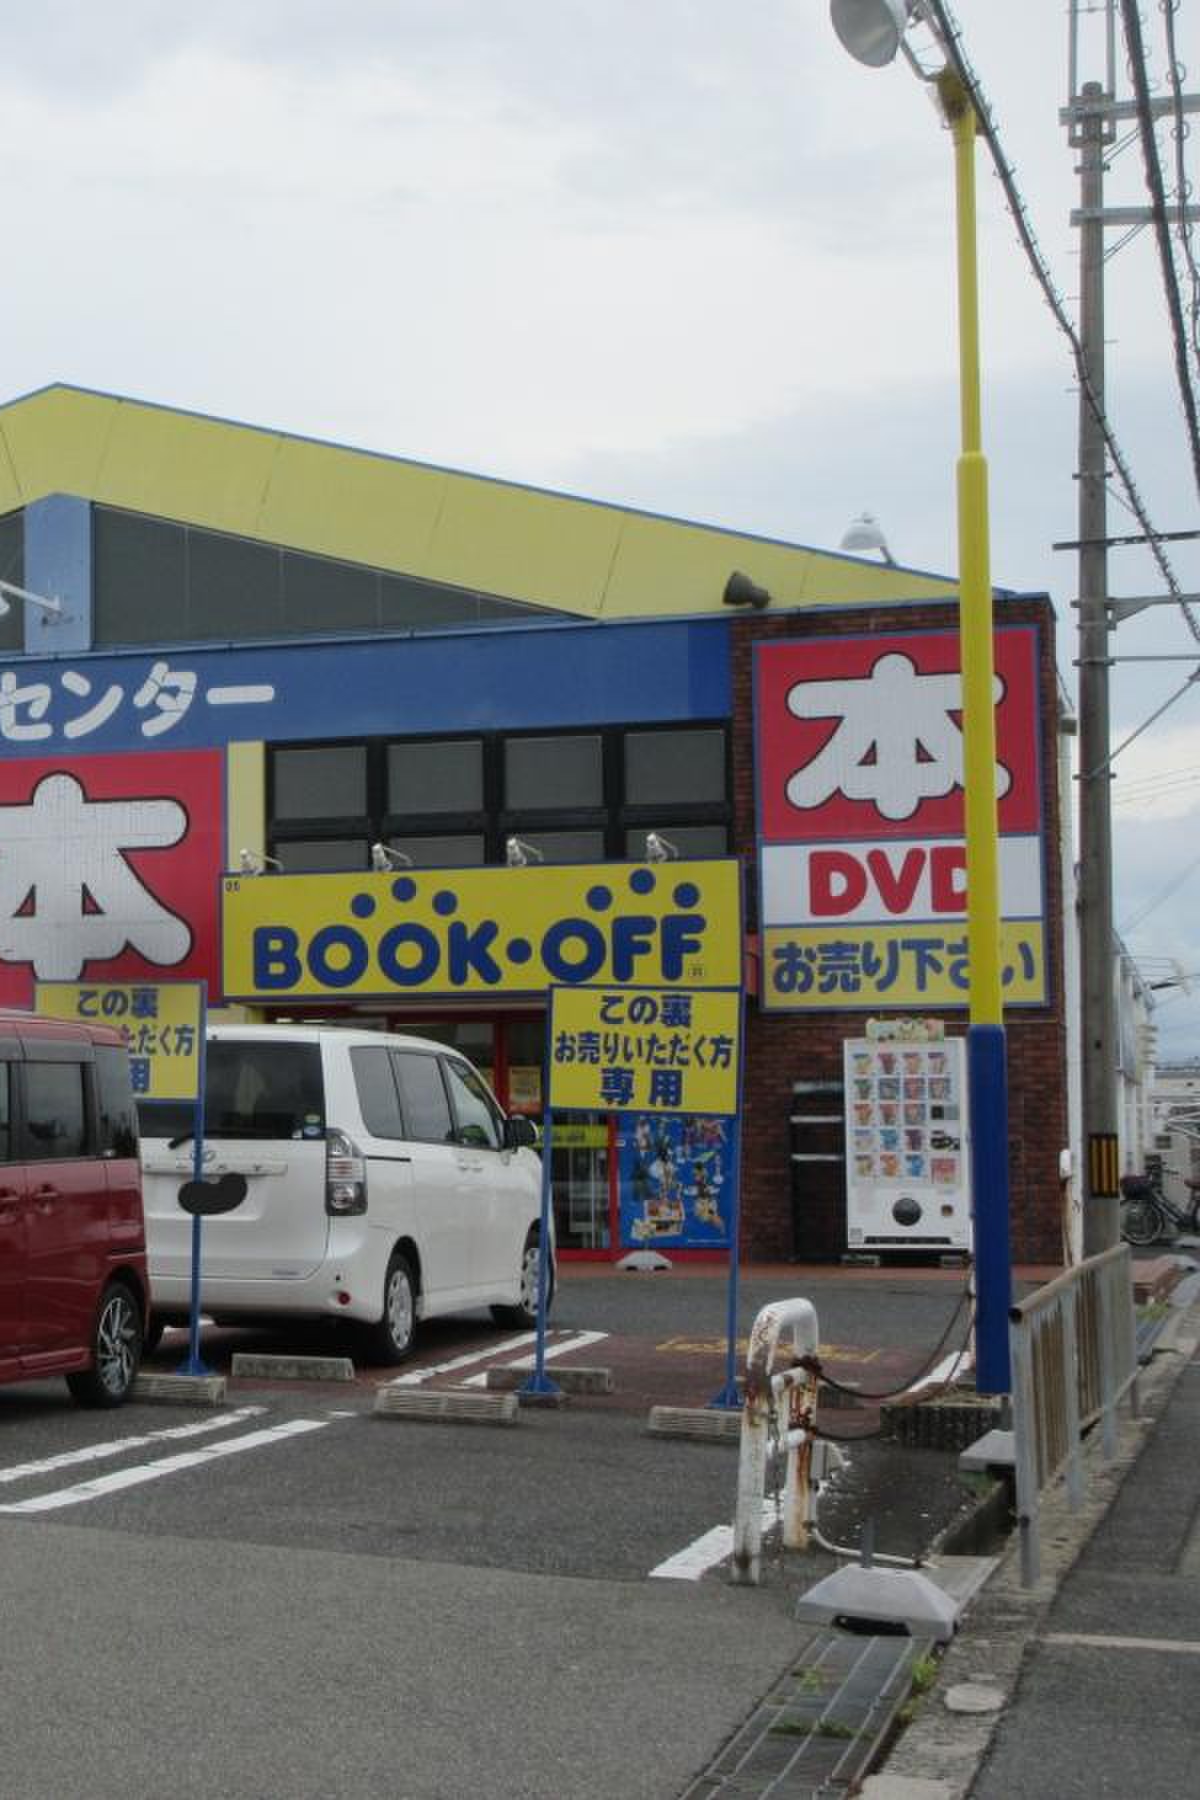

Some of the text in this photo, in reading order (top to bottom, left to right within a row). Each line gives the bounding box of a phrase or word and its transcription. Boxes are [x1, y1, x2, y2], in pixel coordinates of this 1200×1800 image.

[785, 652, 1012, 821] 本
[809, 846, 969, 916] DVD
[78, 987, 158, 1018] この裏
[599, 994, 693, 1028] この裏
[555, 1030, 734, 1069] お売りいただく方
